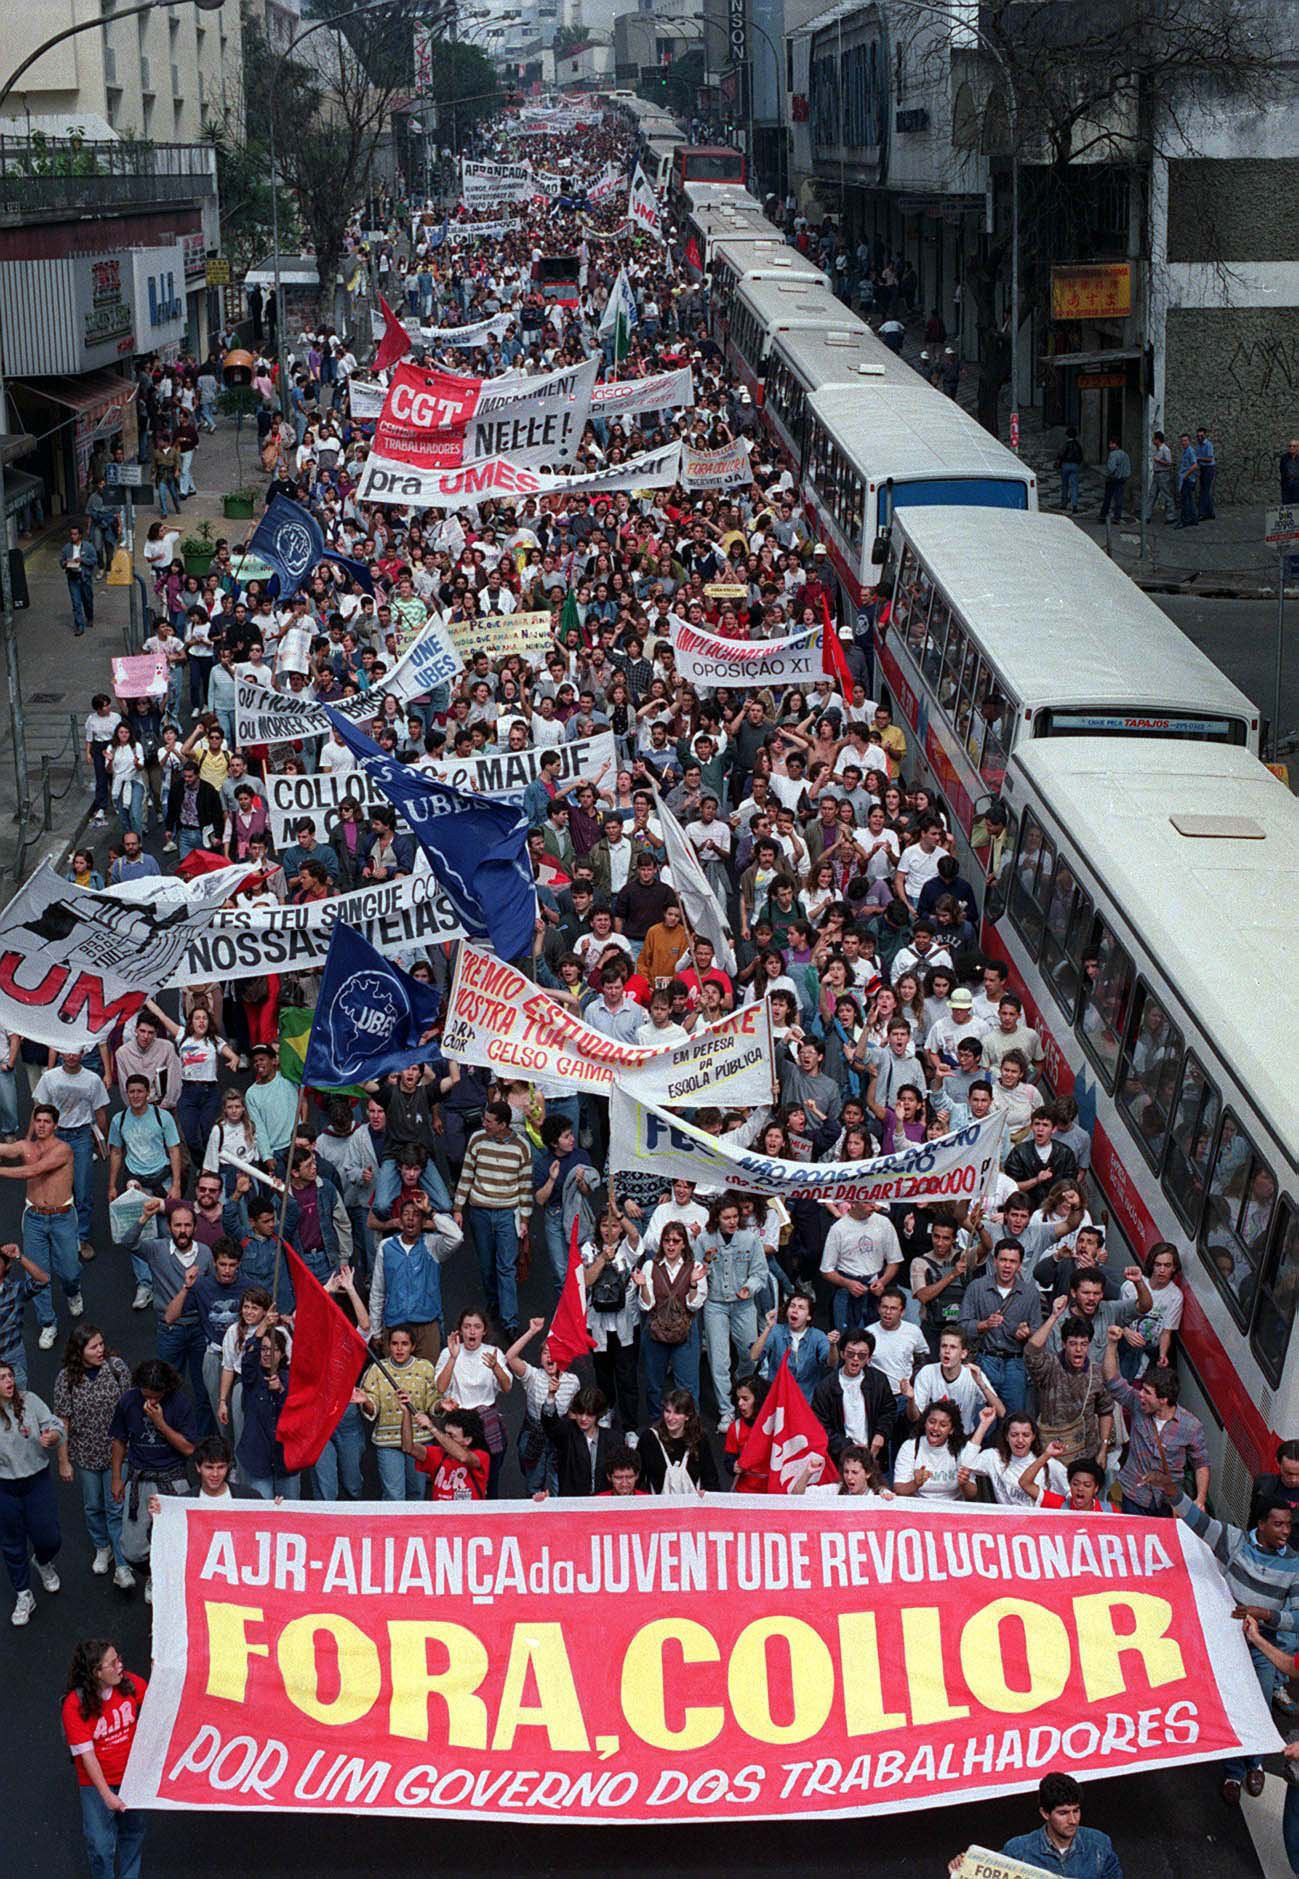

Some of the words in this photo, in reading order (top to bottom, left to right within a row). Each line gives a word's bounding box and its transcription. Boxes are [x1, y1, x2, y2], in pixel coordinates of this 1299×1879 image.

[391, 384, 463, 429] CGT
[384, 437, 461, 456] TRABALHADORES
[363, 466, 422, 498] pra
[438, 460, 541, 495] UMES
[409, 634, 443, 668] UNE
[692, 656, 784, 679] OPOSIÇÃO
[790, 657, 813, 674] XI
[413, 654, 457, 689] UBES
[239, 688, 256, 708] OU
[239, 721, 256, 740] OU
[258, 713, 303, 740] MORRER
[263, 909, 310, 931] TEU
[322, 884, 403, 928] SANGUE
[186, 926, 333, 975] NOSSAS
[487, 1038, 548, 1071] CELSO
[556, 1057, 615, 1084] GAMA
[673, 1048, 689, 1065] EM
[693, 1036, 735, 1060] DEFESA
[699, 1059, 713, 1071] DA
[668, 1074, 710, 1099] ESCOLA
[715, 1046, 763, 1081] PÚBLICA
[200, 1530, 526, 1604] AJR-ALIANÇA
[529, 1545, 575, 1589] da
[577, 1530, 809, 1594] JUVENTUDE
[820, 1526, 1173, 1588] REVOLUCIONÁRIA
[204, 1600, 621, 1761] FORA,
[620, 1590, 1187, 1752] COLLOR
[93, 1701, 135, 1740] AJR
[168, 1724, 289, 1801] POR
[294, 1750, 392, 1804] UM
[394, 1764, 639, 1809] GOVERNO
[646, 1763, 766, 1806] DOS
[778, 1699, 1201, 1800] TRABALHADORES
